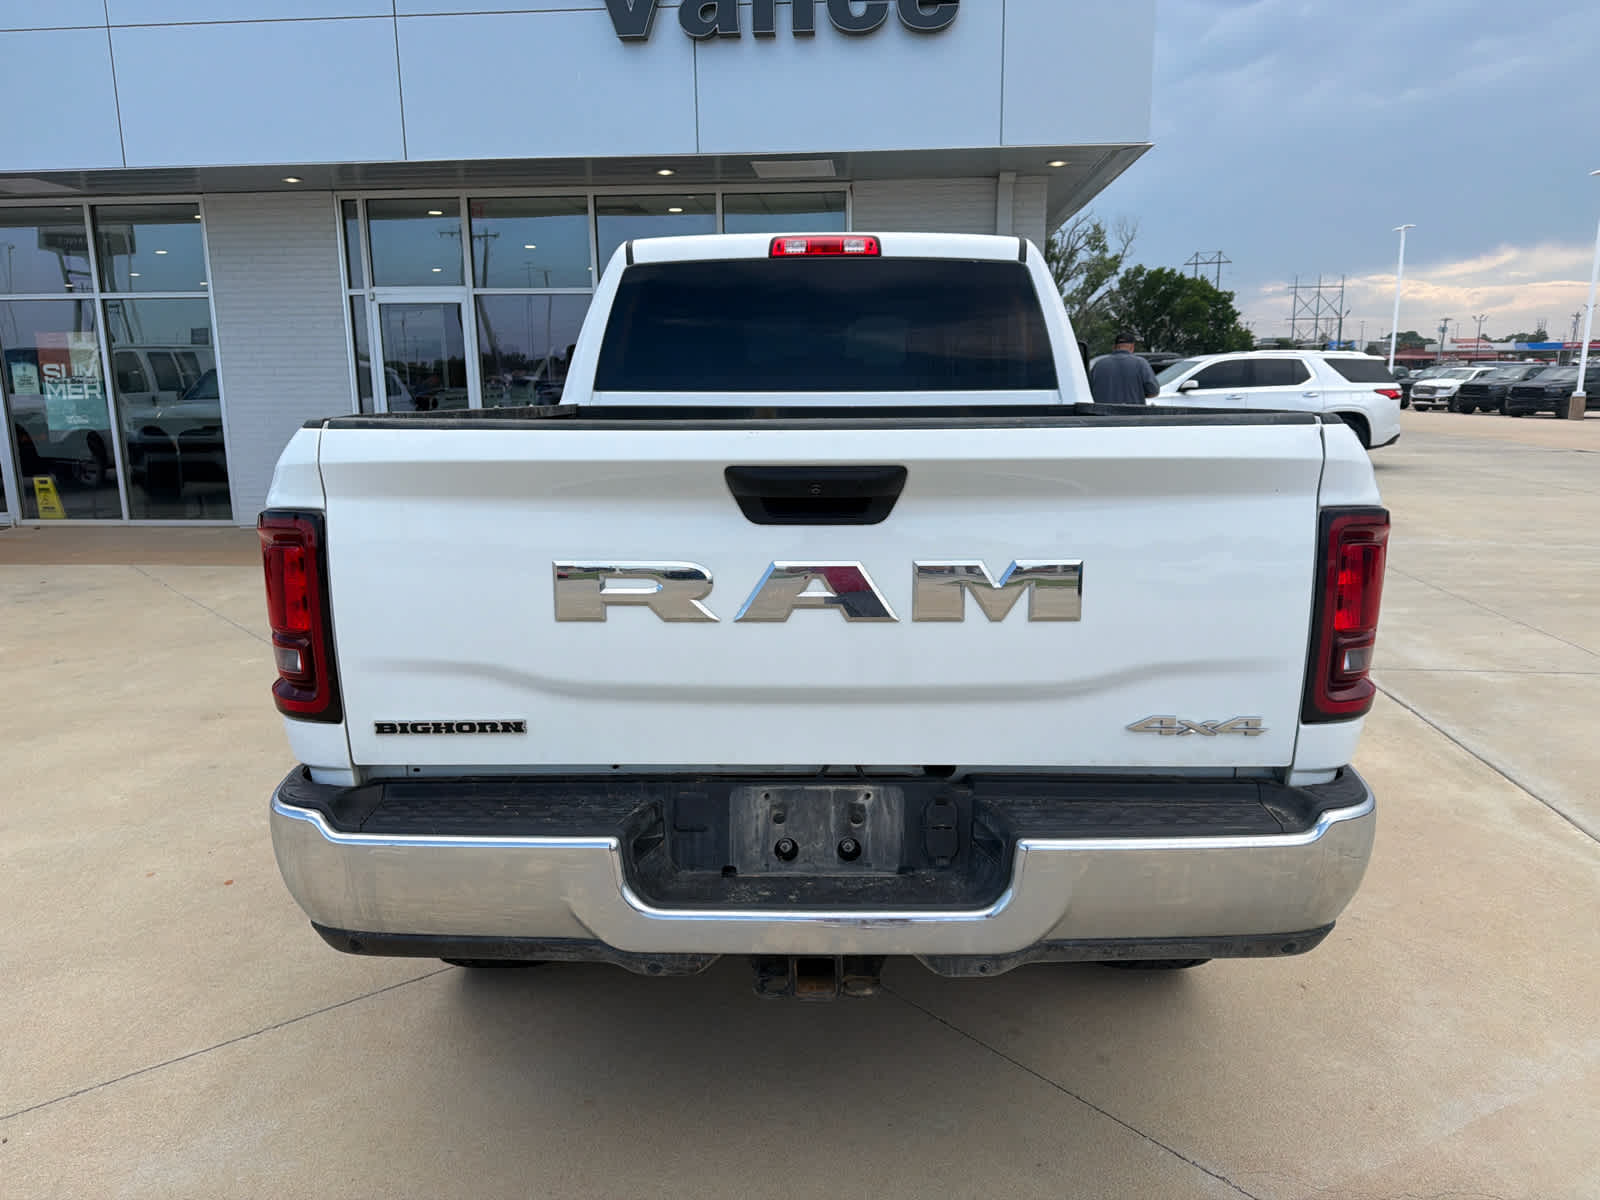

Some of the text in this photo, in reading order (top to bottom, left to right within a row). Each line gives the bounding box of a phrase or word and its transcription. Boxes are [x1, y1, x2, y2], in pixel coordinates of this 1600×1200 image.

[45, 382, 103, 399] MER
[552, 560, 1082, 622] RAM
[374, 720, 527, 735] BIGHORN
[1126, 715, 1269, 736] 4x4
